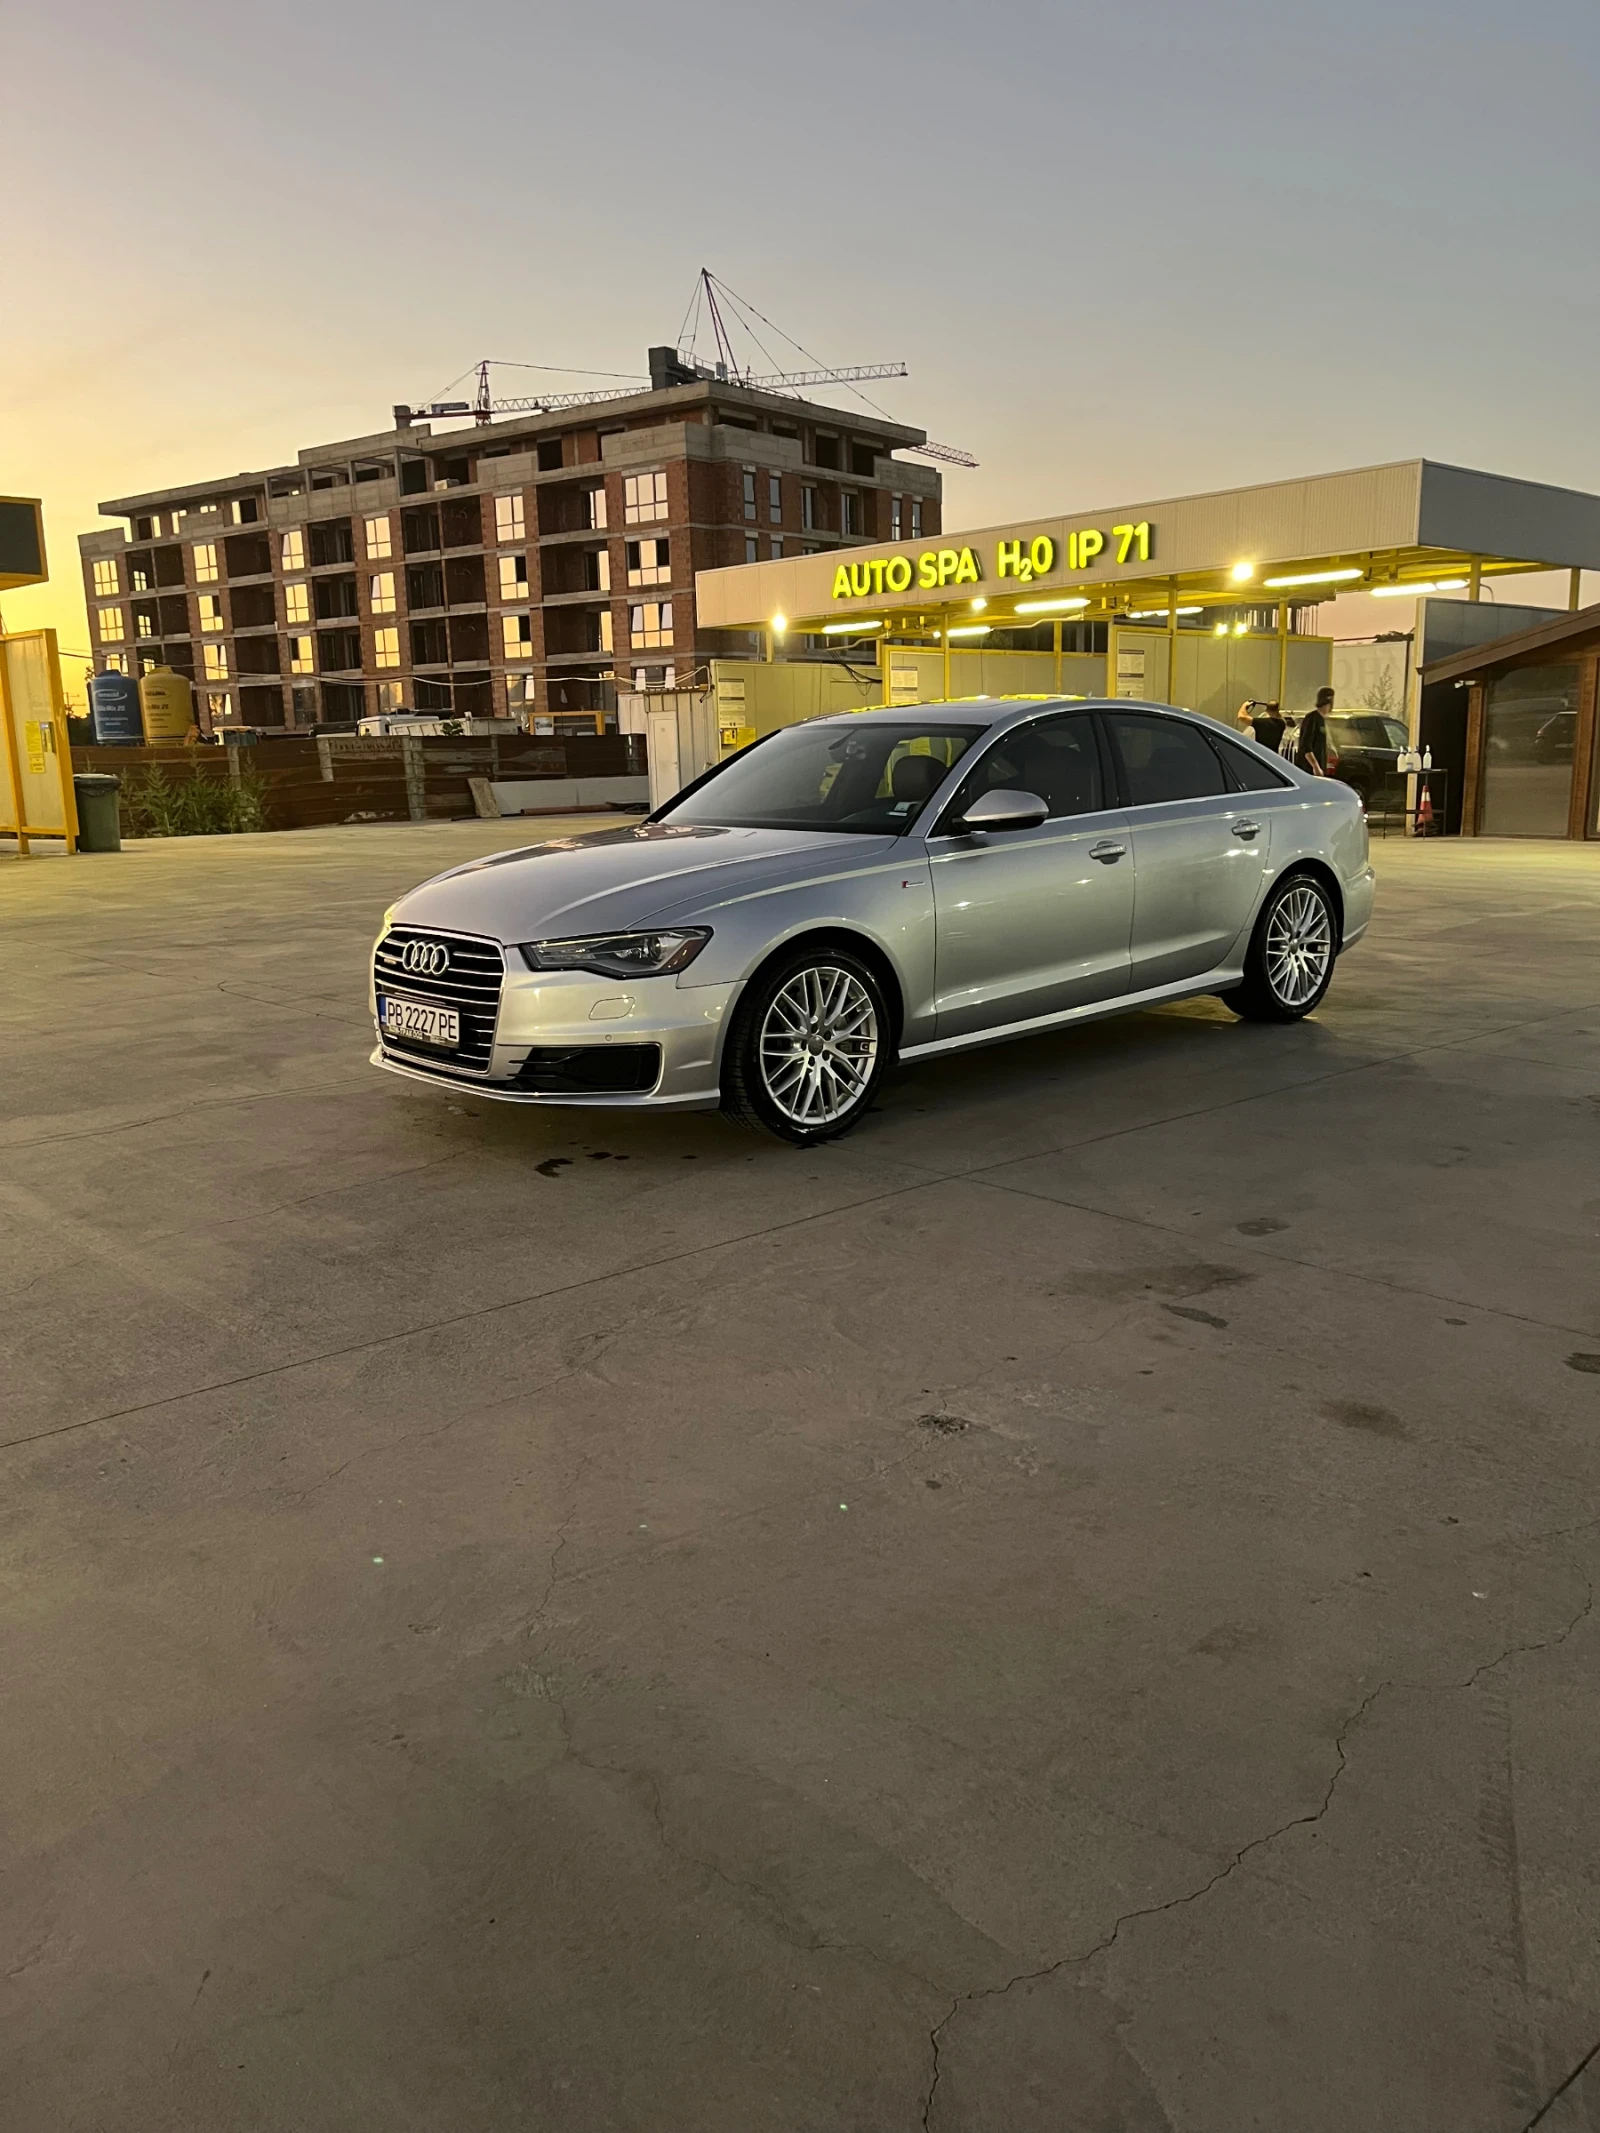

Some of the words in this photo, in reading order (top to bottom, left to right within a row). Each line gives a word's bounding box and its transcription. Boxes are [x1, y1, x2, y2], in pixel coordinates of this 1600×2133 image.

[832, 555, 912, 599] AUTO
[919, 546, 979, 588] SPA
[1069, 529, 1104, 569] IP
[1112, 521, 1149, 563] 71
[388, 1002, 403, 1025] PB
[405, 1006, 435, 1033] 2227
[439, 1013, 457, 1039] PE
